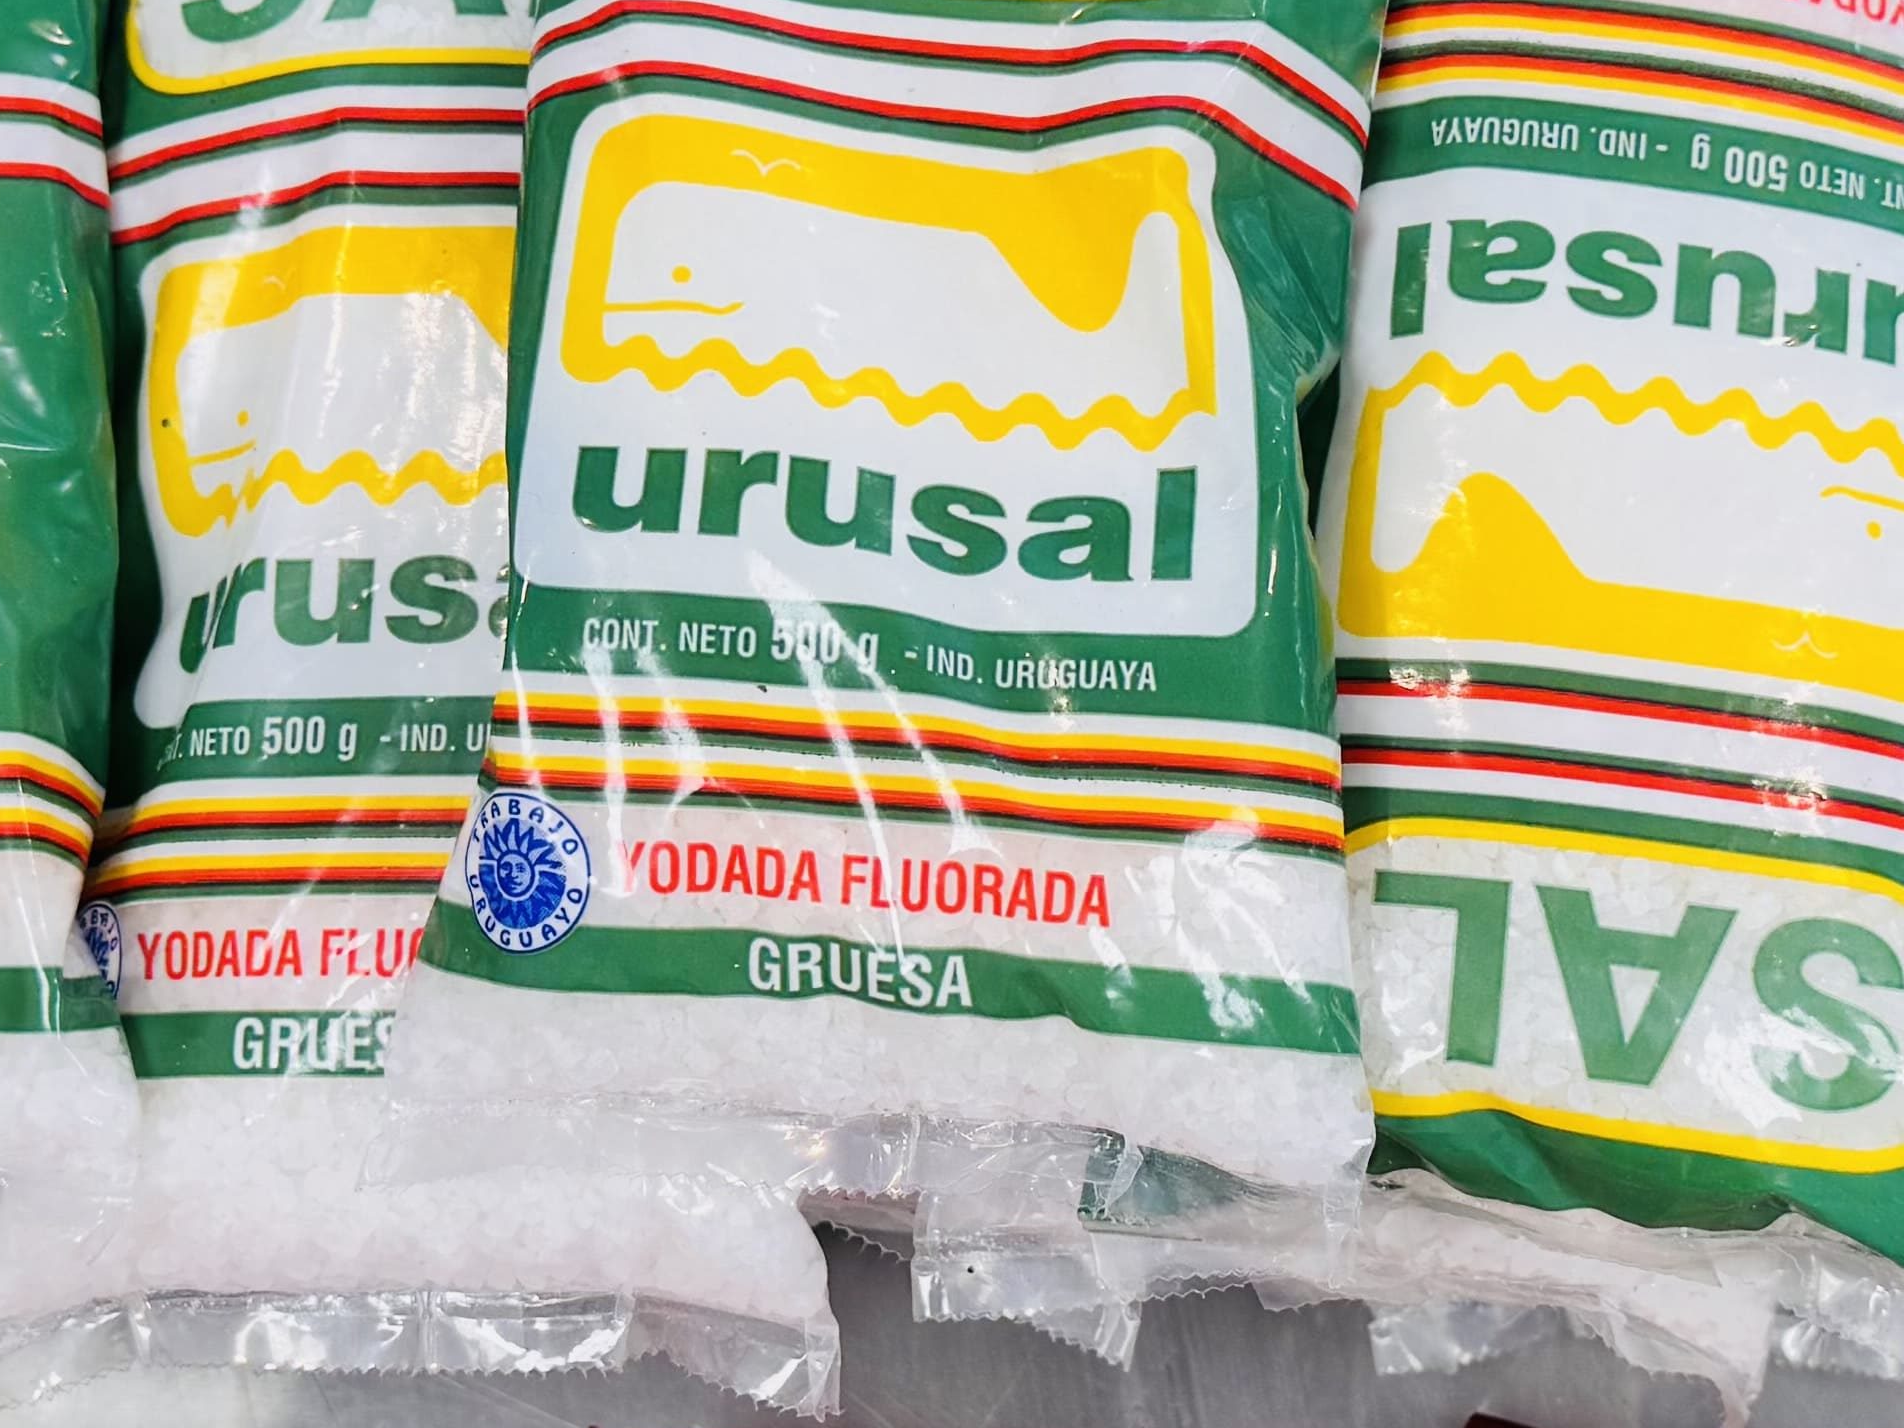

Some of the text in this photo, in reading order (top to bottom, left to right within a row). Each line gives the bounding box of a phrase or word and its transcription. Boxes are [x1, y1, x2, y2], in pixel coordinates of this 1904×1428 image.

[1430, 118, 1581, 154] URUGUAYA
[1596, 126, 1648, 163] IND.
[1691, 133, 1712, 166] g
[1726, 144, 1789, 194] 500
[1800, 163, 1866, 202] NETO
[571, 443, 1198, 584] urusal
[583, 617, 1158, 693] CONT. NETO 500 g IND. URUGUAYA
[188, 722, 251, 759] NETO
[260, 713, 328, 756] 500
[338, 719, 358, 760] g
[399, 718, 459, 754] IND.
[619, 841, 1112, 927] YODADA FLUORADA
[136, 928, 299, 982] YODADA
[747, 938, 973, 1007] GRUESA
